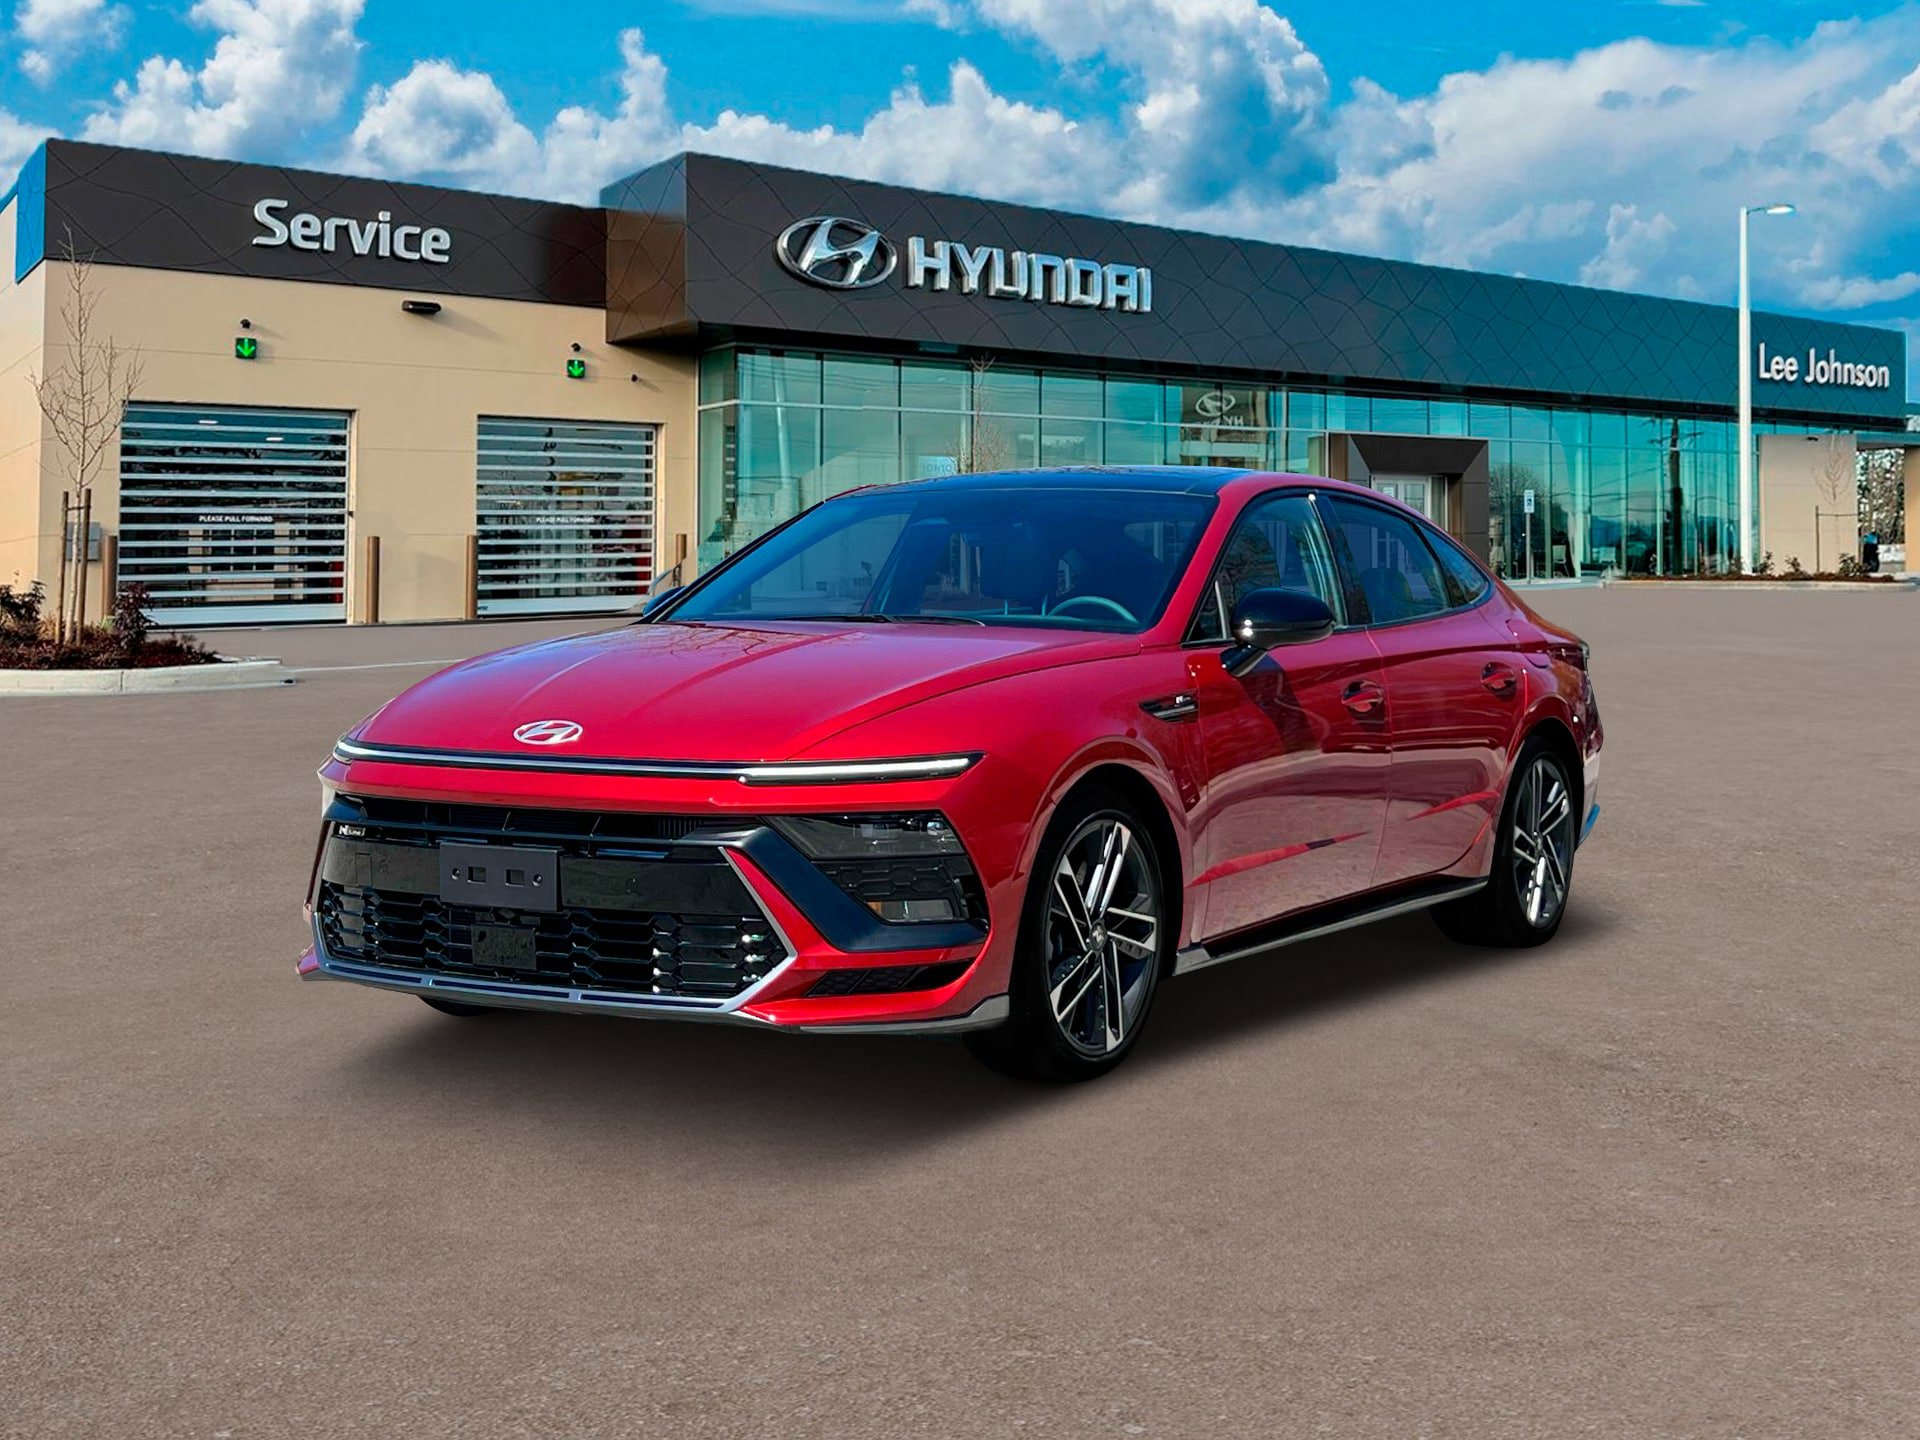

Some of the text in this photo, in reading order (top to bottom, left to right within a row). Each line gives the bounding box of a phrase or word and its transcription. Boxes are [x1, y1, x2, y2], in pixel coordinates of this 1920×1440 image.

[252, 198, 451, 264] Service
[907, 236, 1153, 313] HYUNDAI
[1758, 342, 1890, 388] Lee Johnson
[199, 515, 273, 523] PLEASE PULL FORWARD
